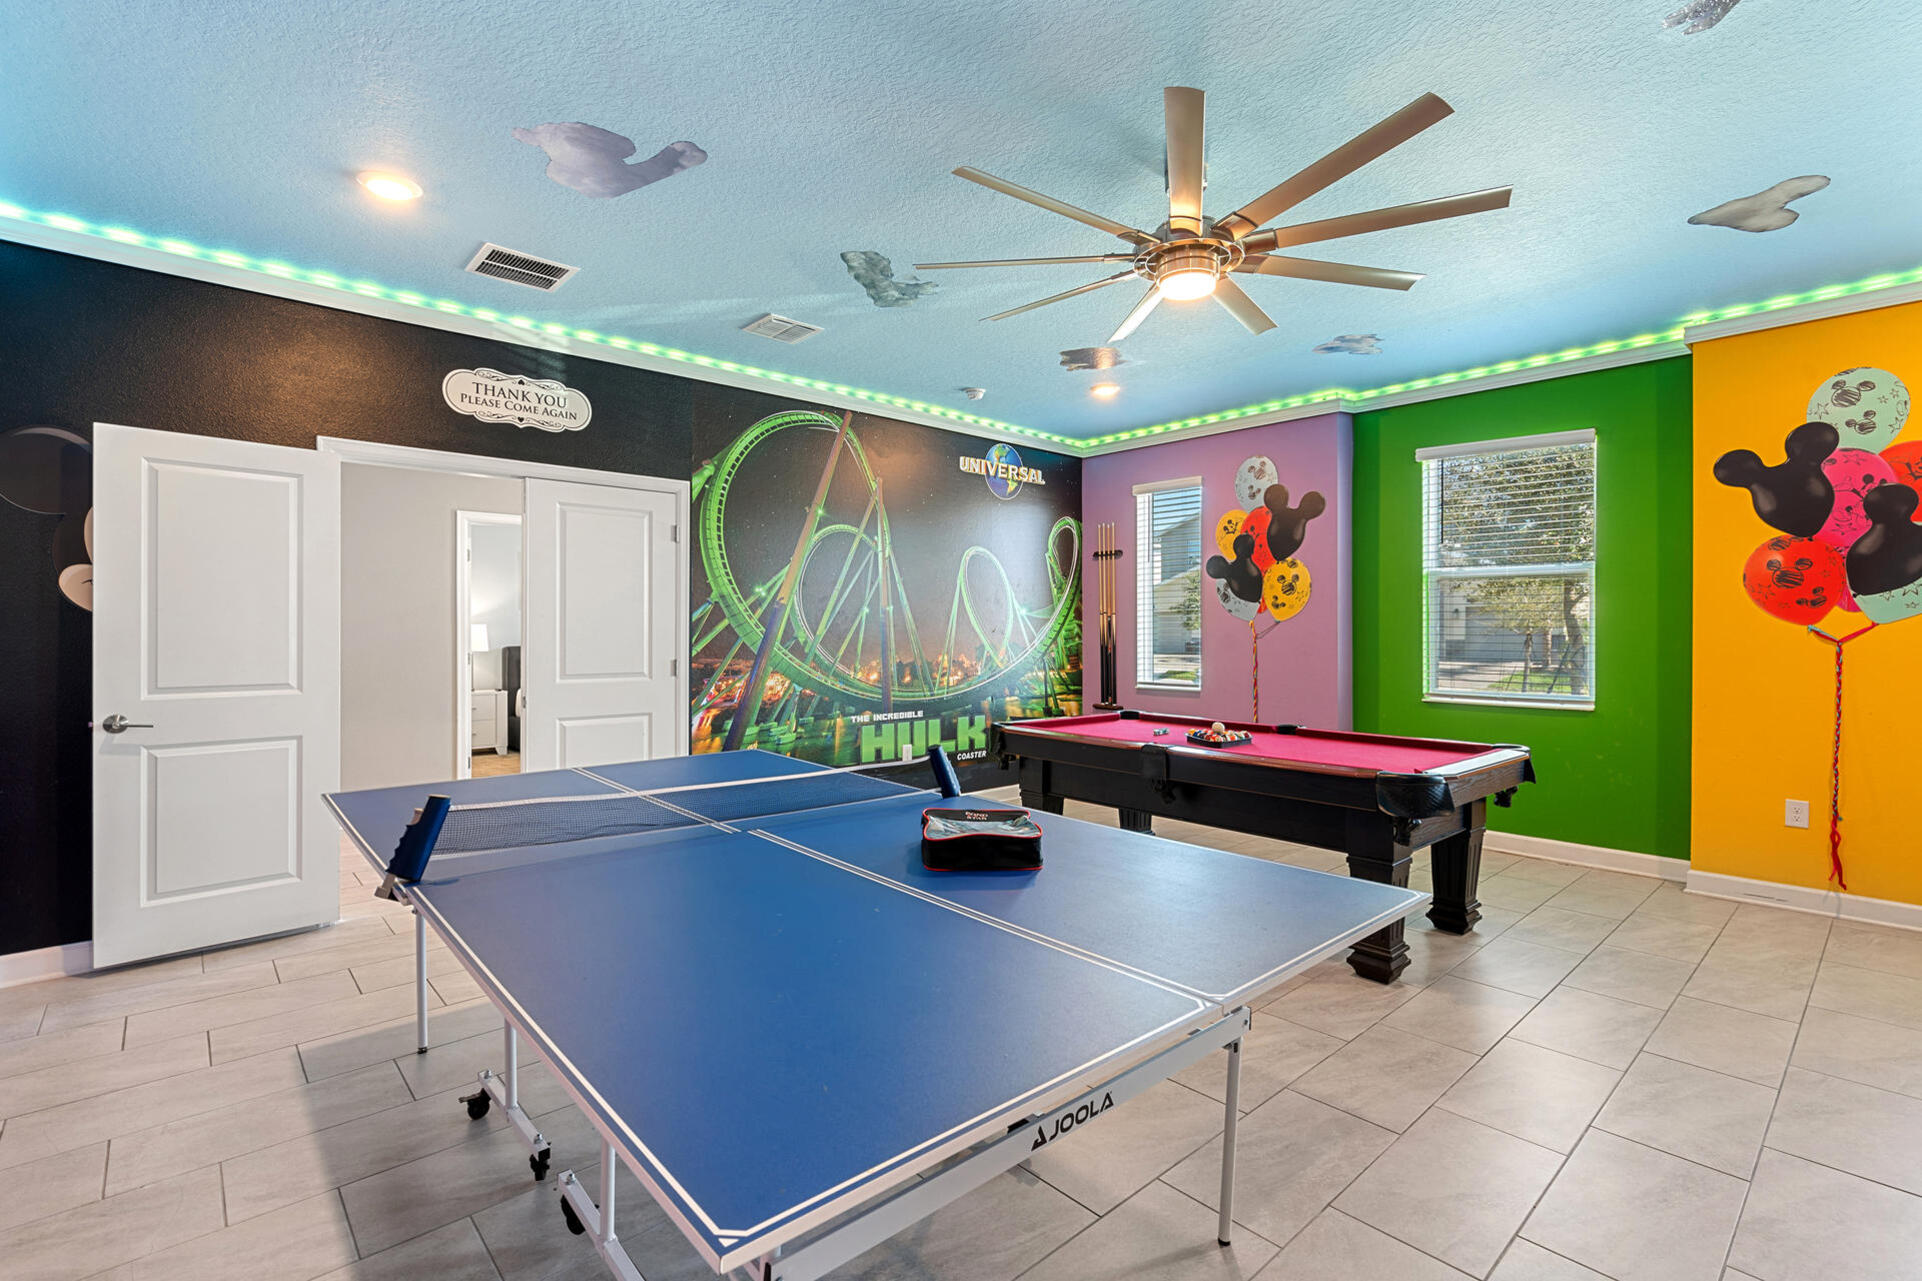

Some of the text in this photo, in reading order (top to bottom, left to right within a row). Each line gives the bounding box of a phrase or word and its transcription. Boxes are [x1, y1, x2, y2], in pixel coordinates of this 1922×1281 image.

[460, 393, 578, 421] PLEASE COME AGAIN
[472, 381, 568, 409] THANK YOU
[960, 456, 1046, 485] UNIVERSAL
[851, 710, 924, 723] THE INCREDIBLE
[861, 715, 987, 763] HULK
[956, 750, 987, 761] COASTER
[1048, 1091, 1114, 1142] JOOLA
